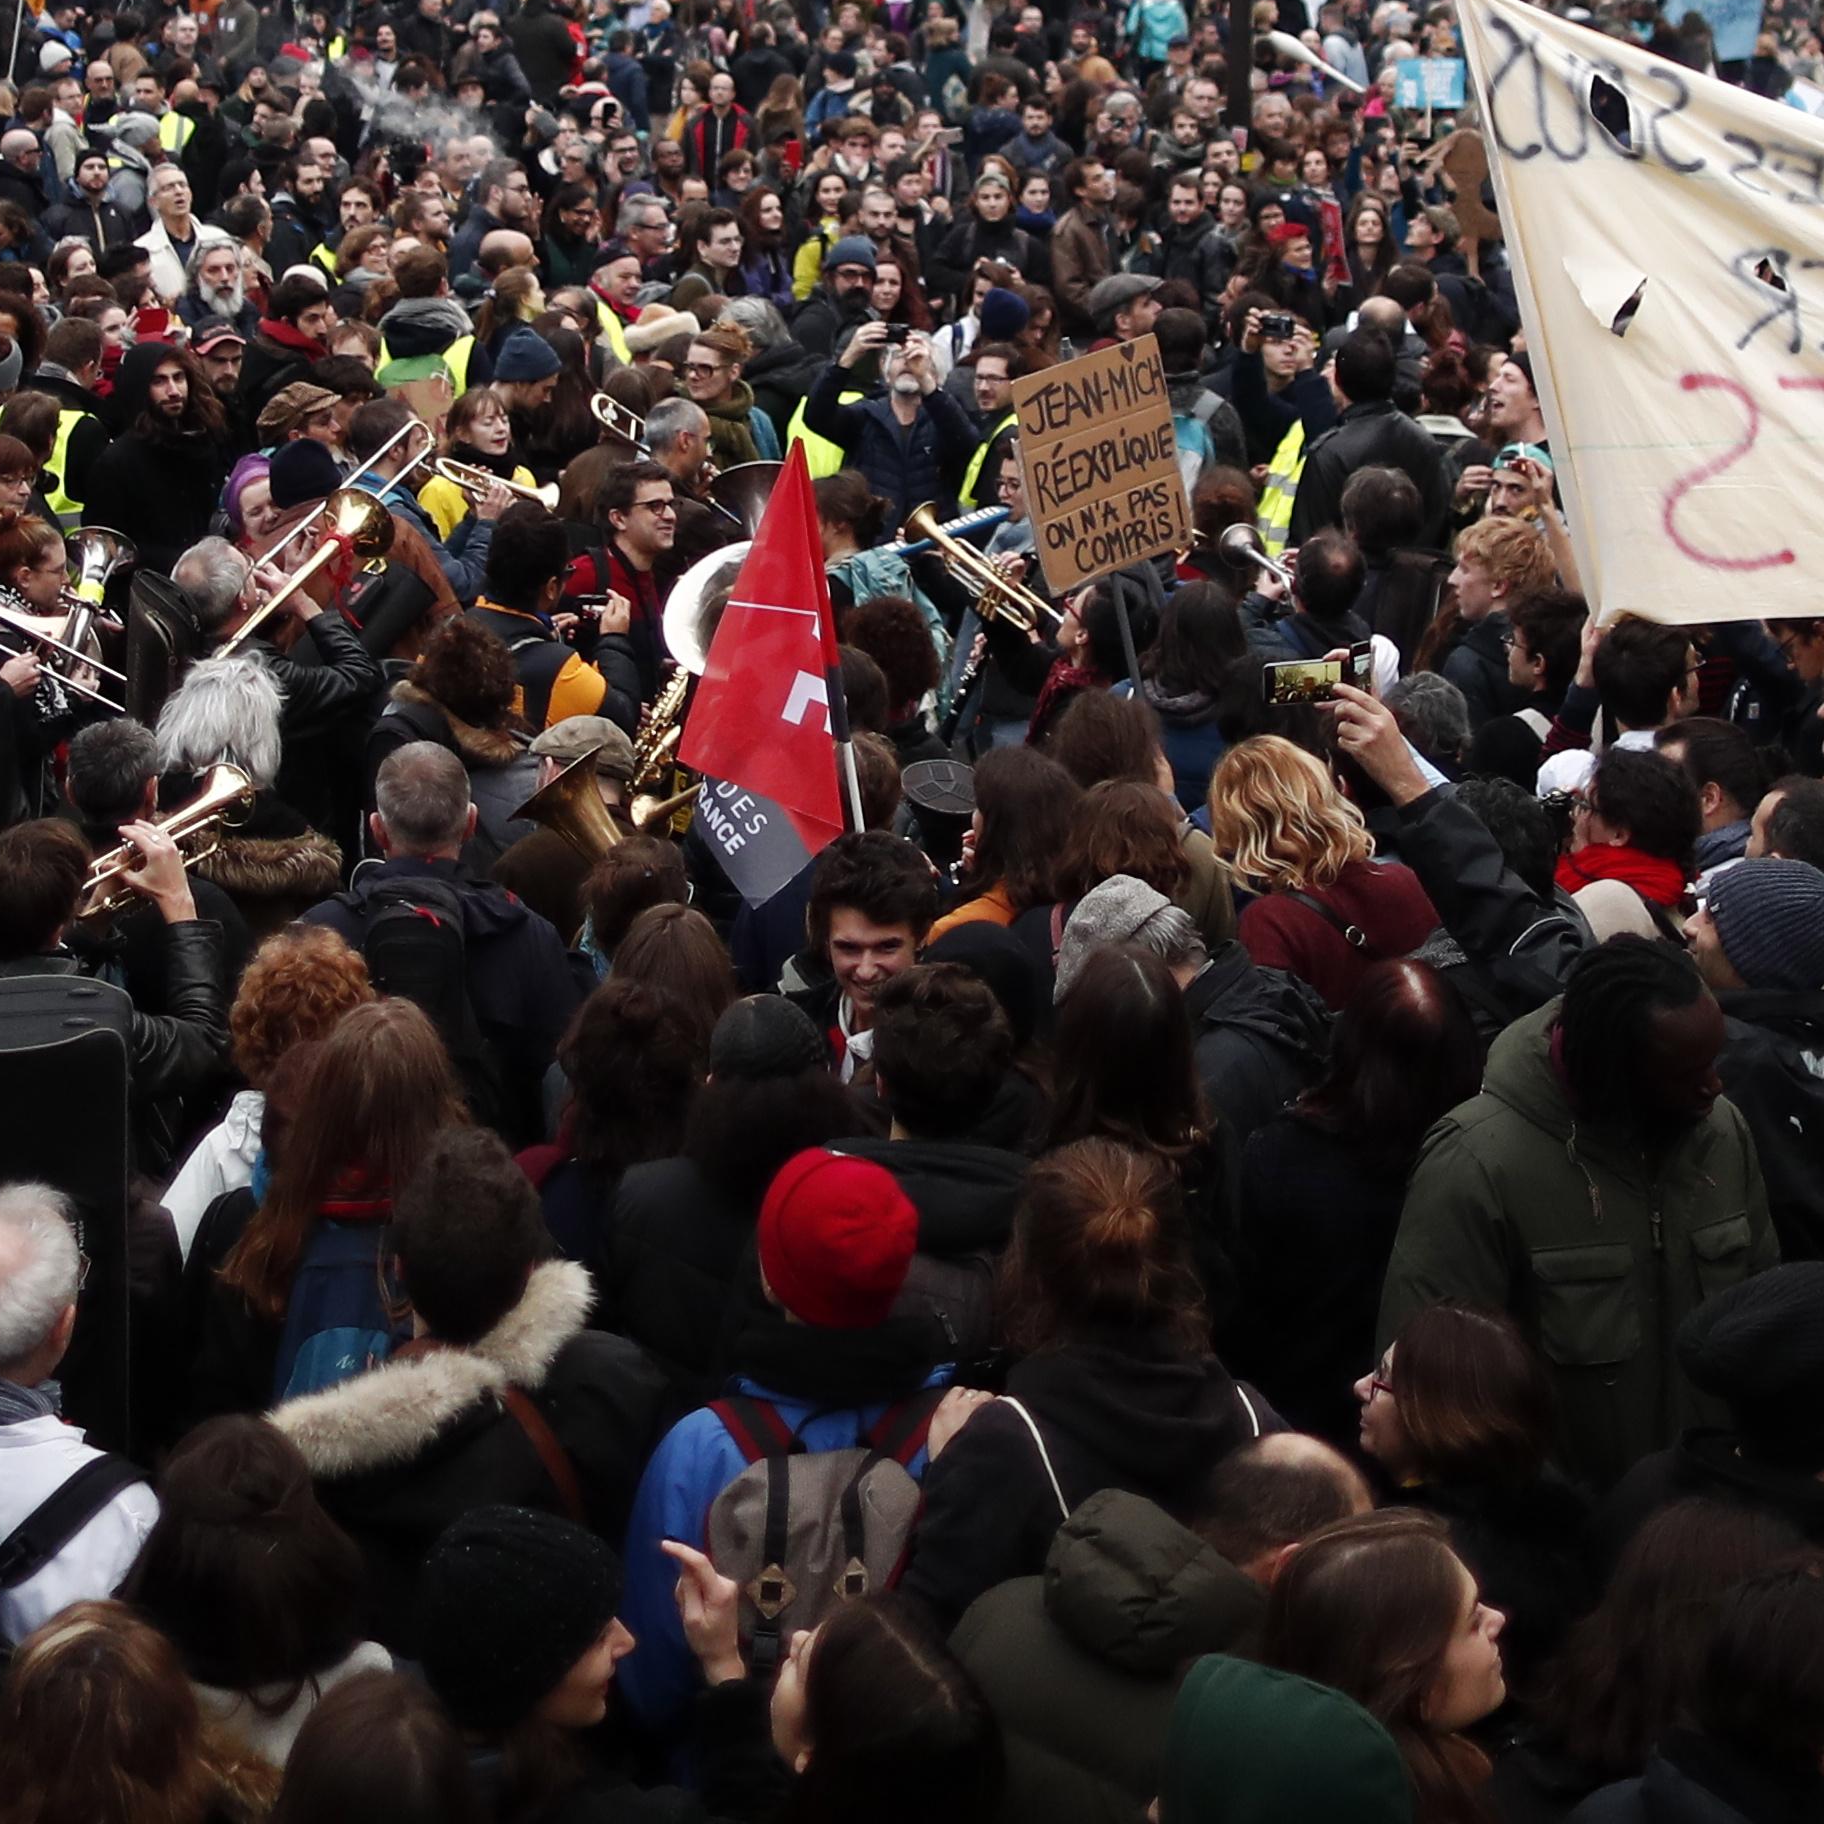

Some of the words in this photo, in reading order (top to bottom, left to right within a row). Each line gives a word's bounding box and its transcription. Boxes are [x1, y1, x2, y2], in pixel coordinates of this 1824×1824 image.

[1045, 516, 1075, 550] ON
[1079, 499, 1121, 535] N'A
[1127, 481, 1171, 519] PAS
